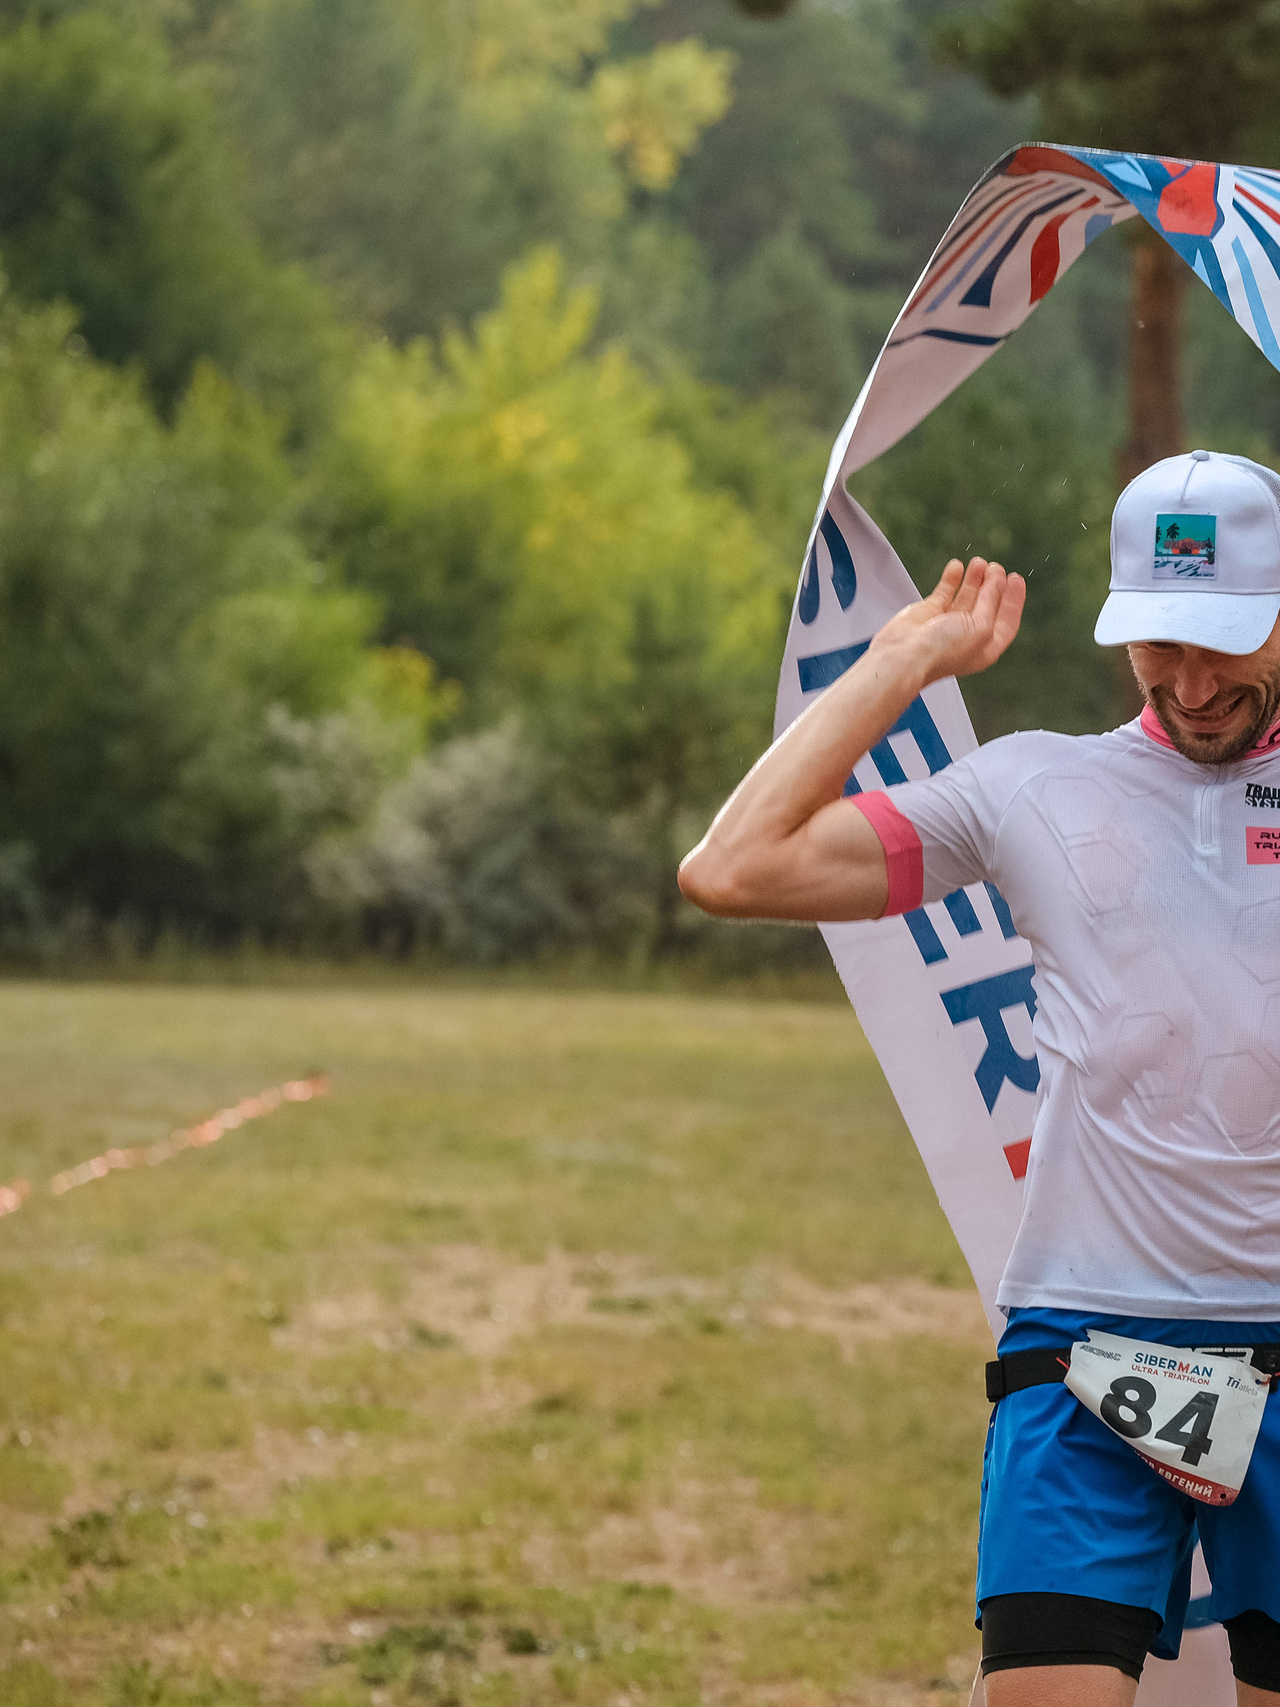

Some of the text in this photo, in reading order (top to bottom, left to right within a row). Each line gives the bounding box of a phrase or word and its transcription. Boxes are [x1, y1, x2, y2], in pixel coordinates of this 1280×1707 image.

[1131, 1364, 1211, 1386] ULTRA TRIATHLON
[1133, 1352, 1214, 1378] SIBERMAN
[1100, 1376, 1220, 1467] 84
[1158, 1467, 1213, 1498] ЕВГЕНИЙ
